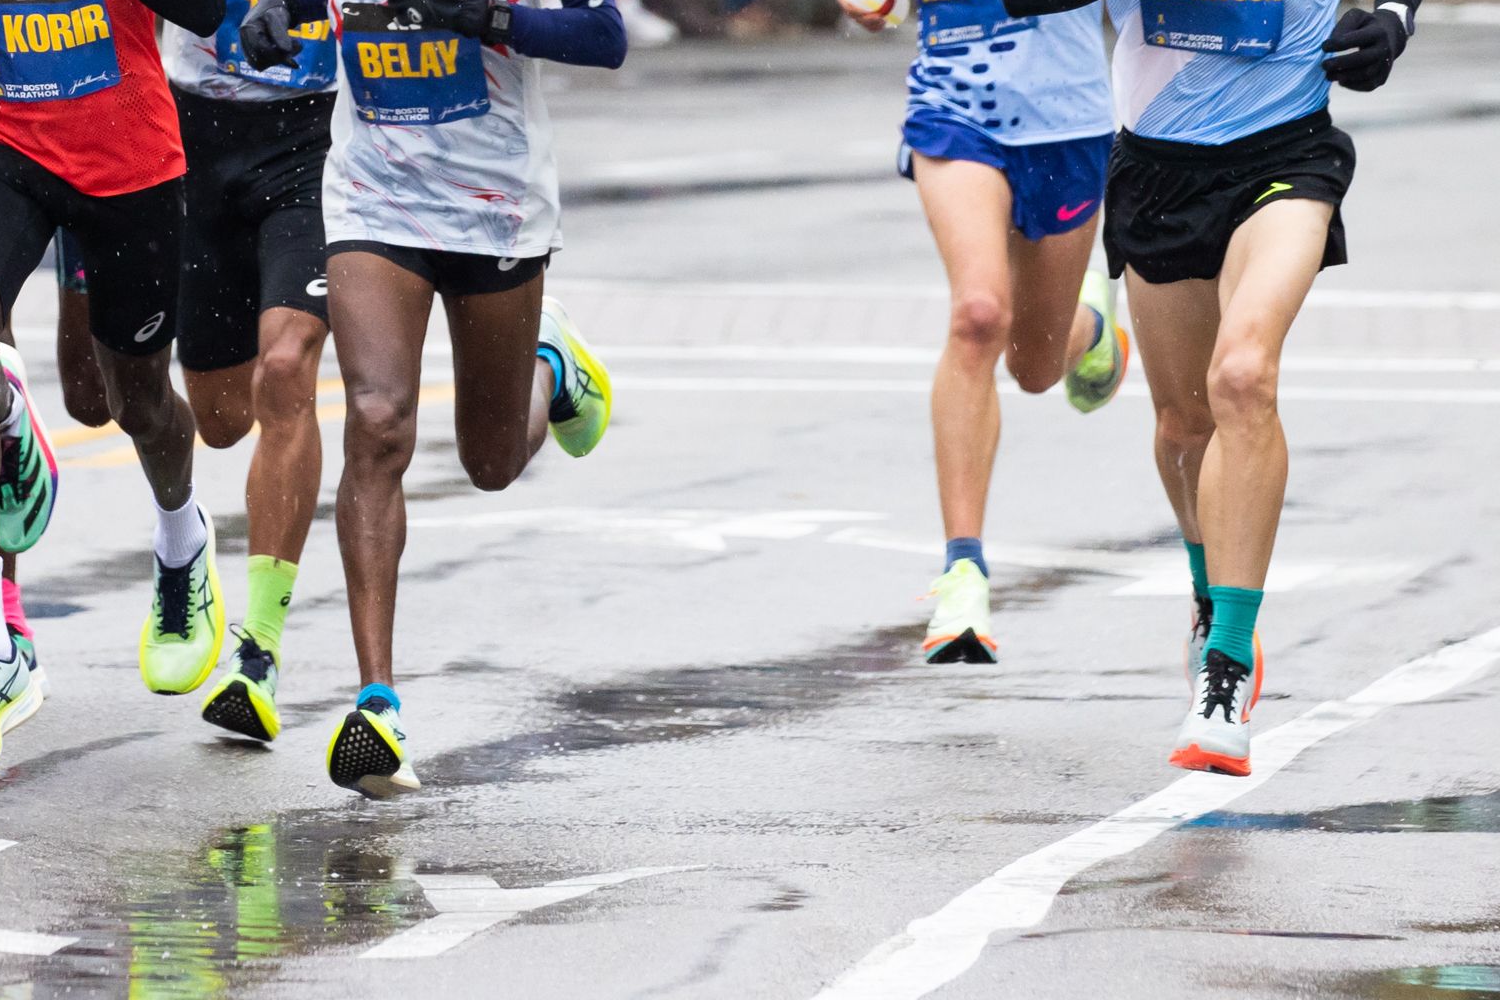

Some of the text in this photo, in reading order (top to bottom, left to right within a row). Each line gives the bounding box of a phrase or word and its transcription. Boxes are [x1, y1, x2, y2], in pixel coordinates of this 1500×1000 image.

[2, 4, 111, 53] KORIR
[1188, 34, 1223, 43] BOSTON
[1169, 39, 1223, 51] MARATHON
[357, 38, 459, 79] BELAY
[22, 82, 58, 92] BOSTON
[6, 89, 60, 99] MARATHON
[394, 107, 430, 115] BOSTON
